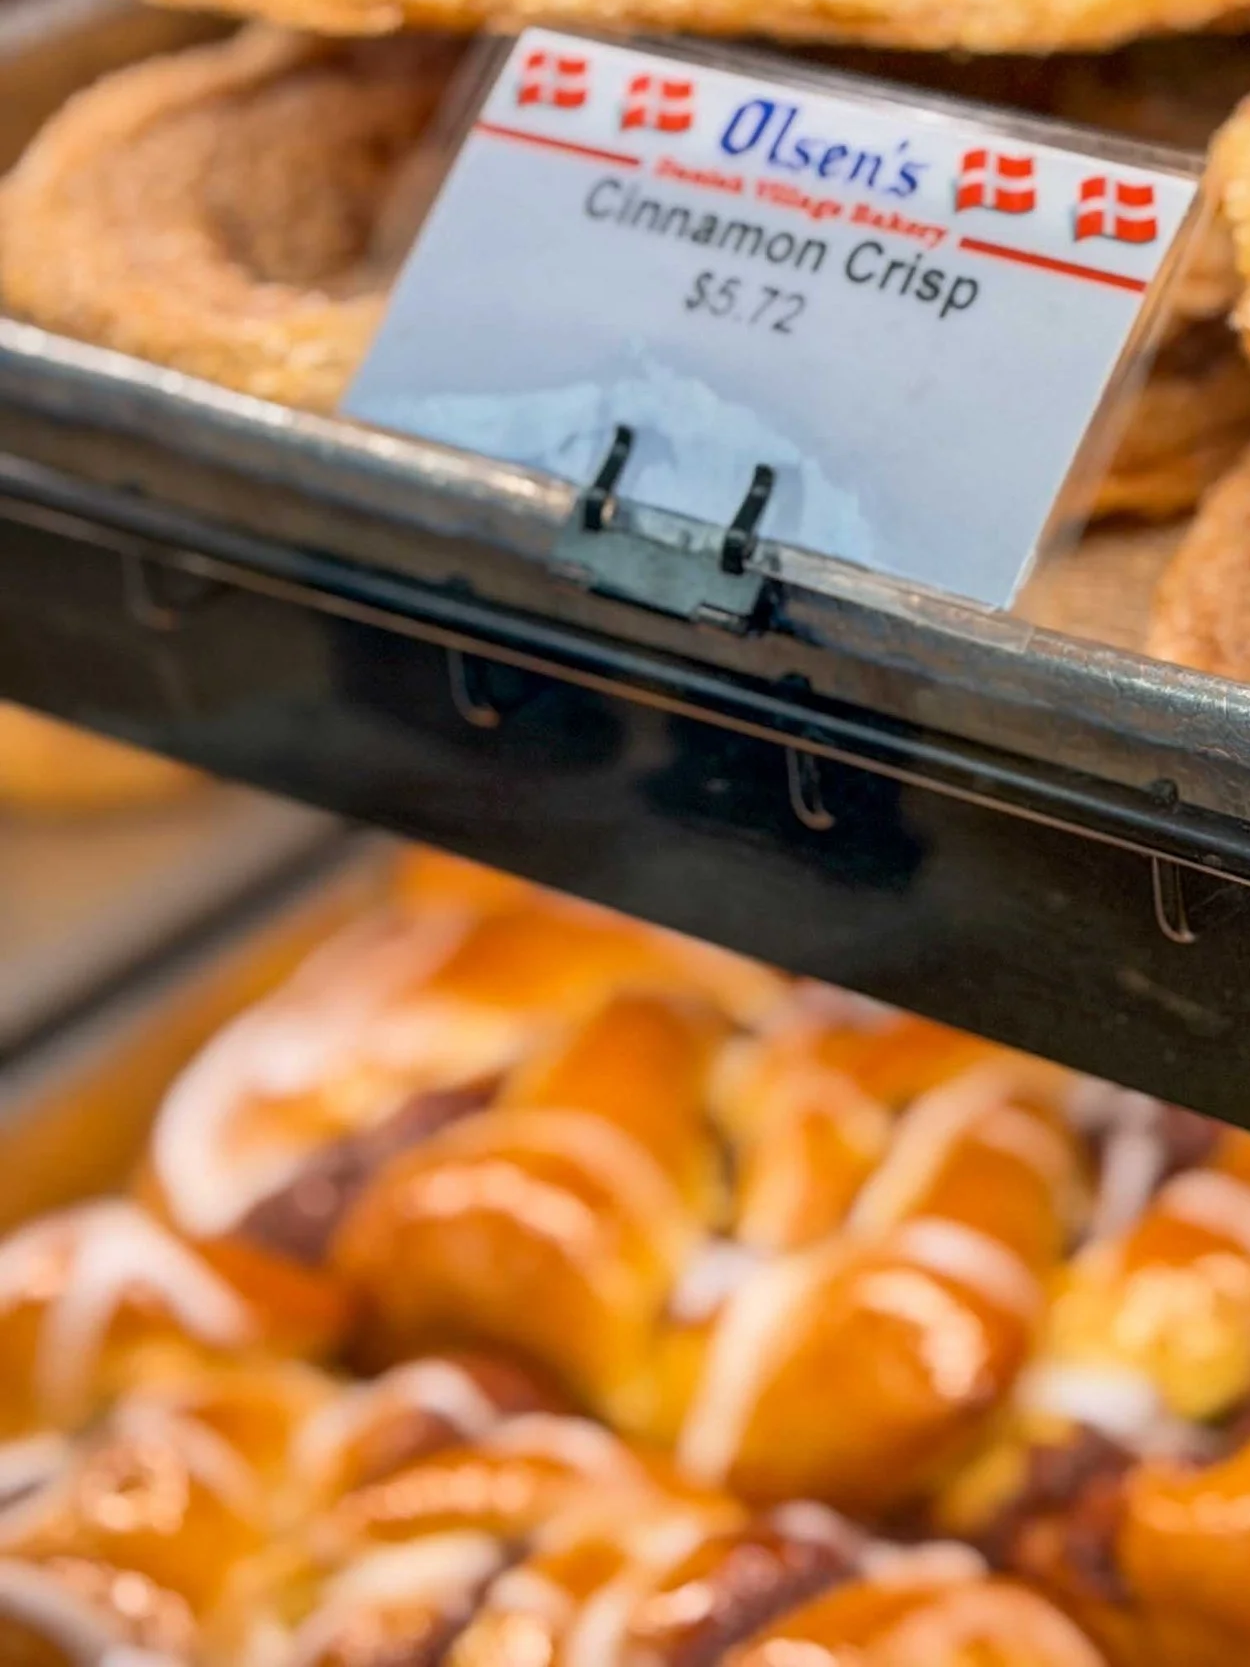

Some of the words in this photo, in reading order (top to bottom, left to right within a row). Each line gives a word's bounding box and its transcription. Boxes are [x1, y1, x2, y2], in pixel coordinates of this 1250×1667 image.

[720, 98, 926, 197] Olsen's
[583, 179, 826, 273] Cinnamon
[844, 241, 981, 318] Crisp
[755, 178, 841, 219] Village
[849, 202, 948, 247] Bakery
[684, 271, 807, 334] $5.72
